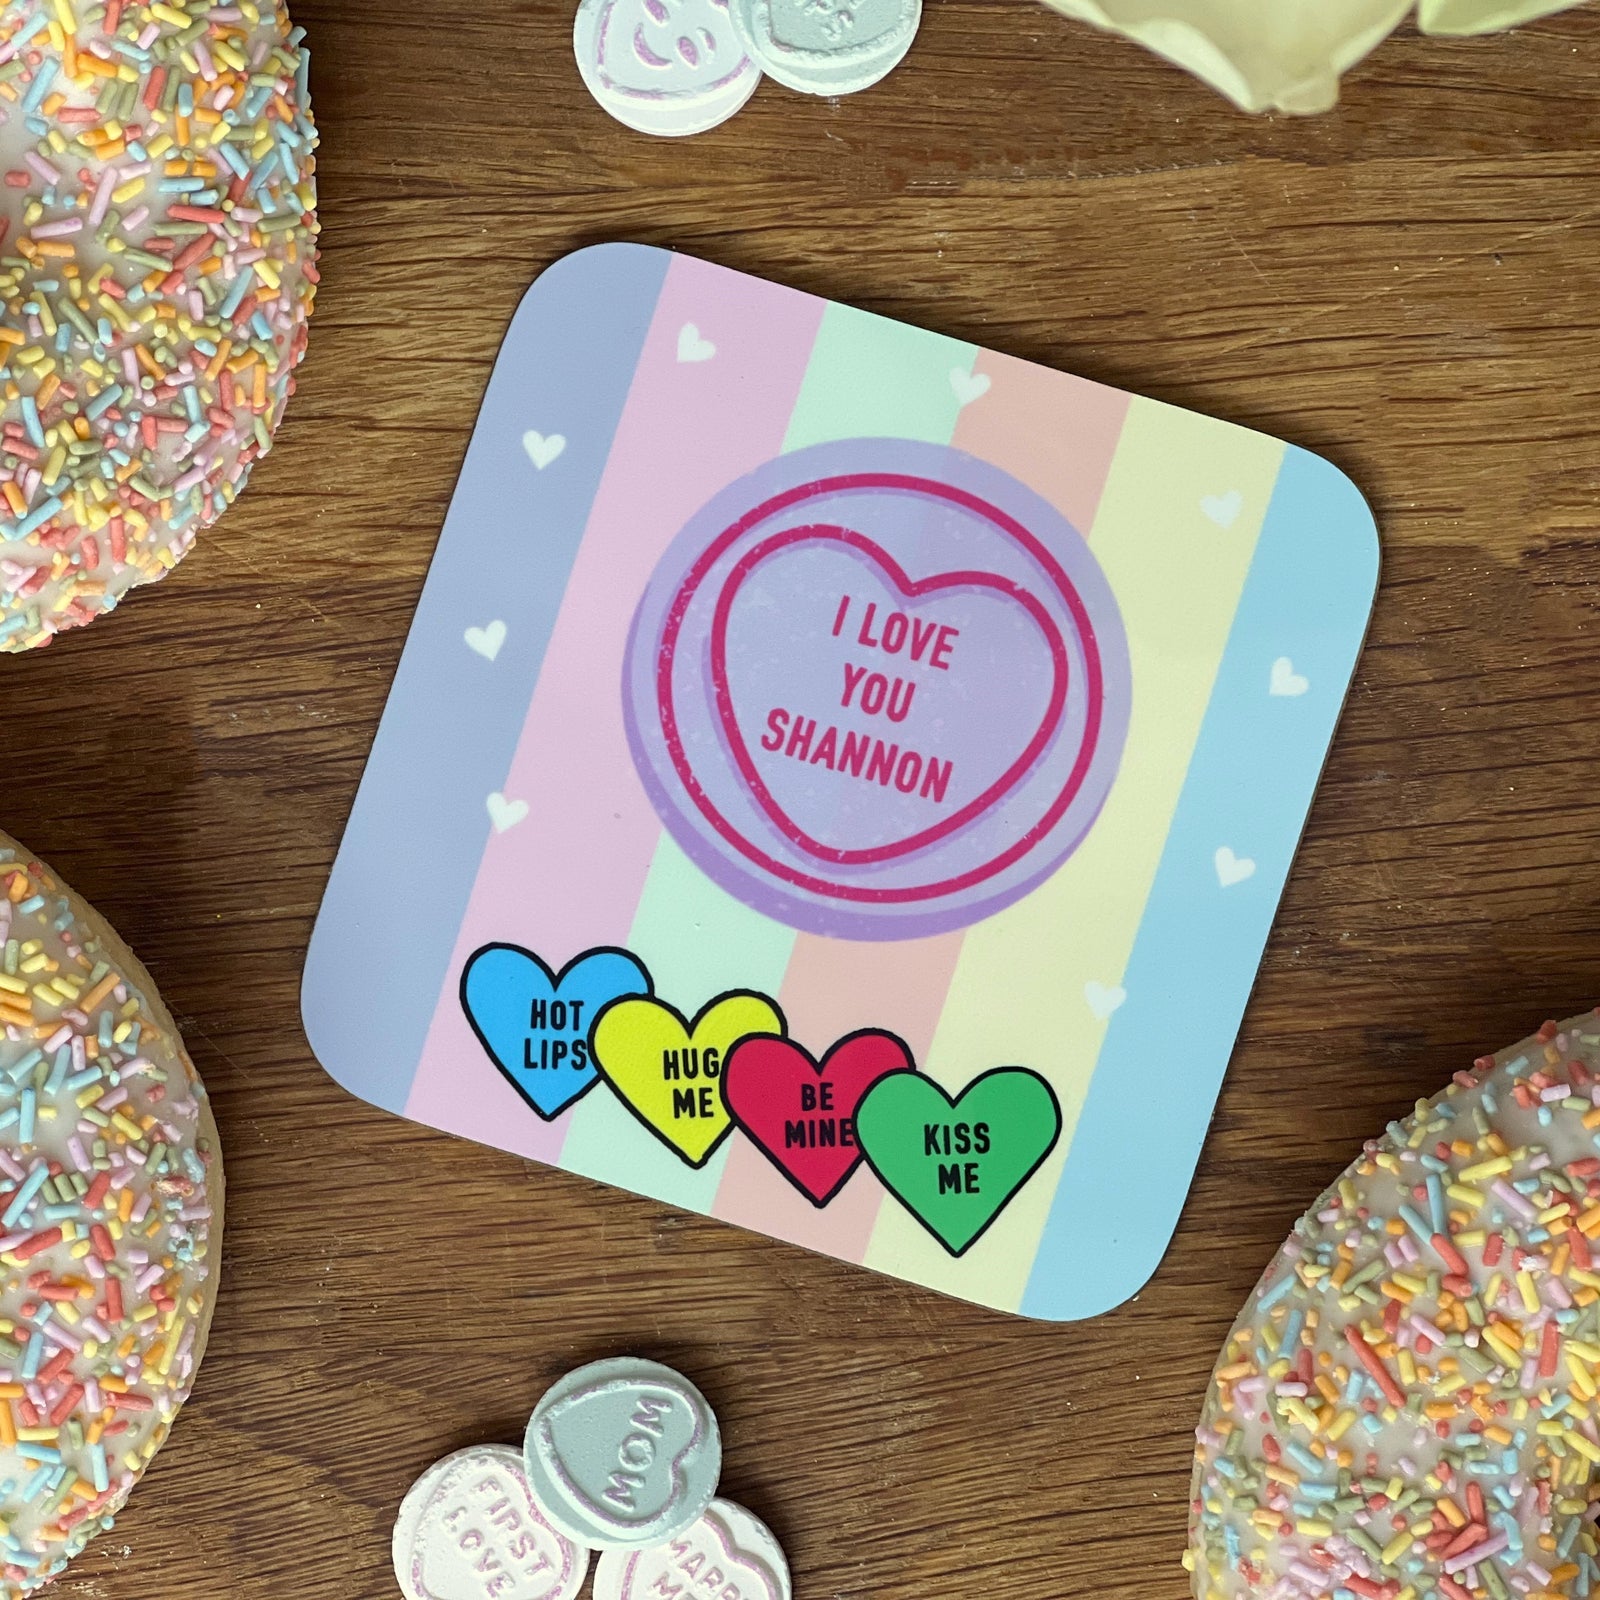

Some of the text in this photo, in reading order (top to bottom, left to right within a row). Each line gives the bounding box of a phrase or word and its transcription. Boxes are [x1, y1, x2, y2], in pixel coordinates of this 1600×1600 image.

[832, 594, 960, 671] I LOVE
[840, 662, 916, 722] YOU
[760, 707, 954, 803] SHANNON
[530, 998, 585, 1031] HOT
[523, 1038, 588, 1070] LIPS
[662, 1048, 720, 1080] HUG
[673, 1086, 715, 1119] ME
[800, 1082, 835, 1112] BE
[784, 1116, 855, 1149] MINE
[923, 1122, 991, 1155] KISS
[938, 1162, 981, 1194] ME
[470, 1475, 555, 1576] FIRST
[442, 1505, 516, 1599] LOVE
